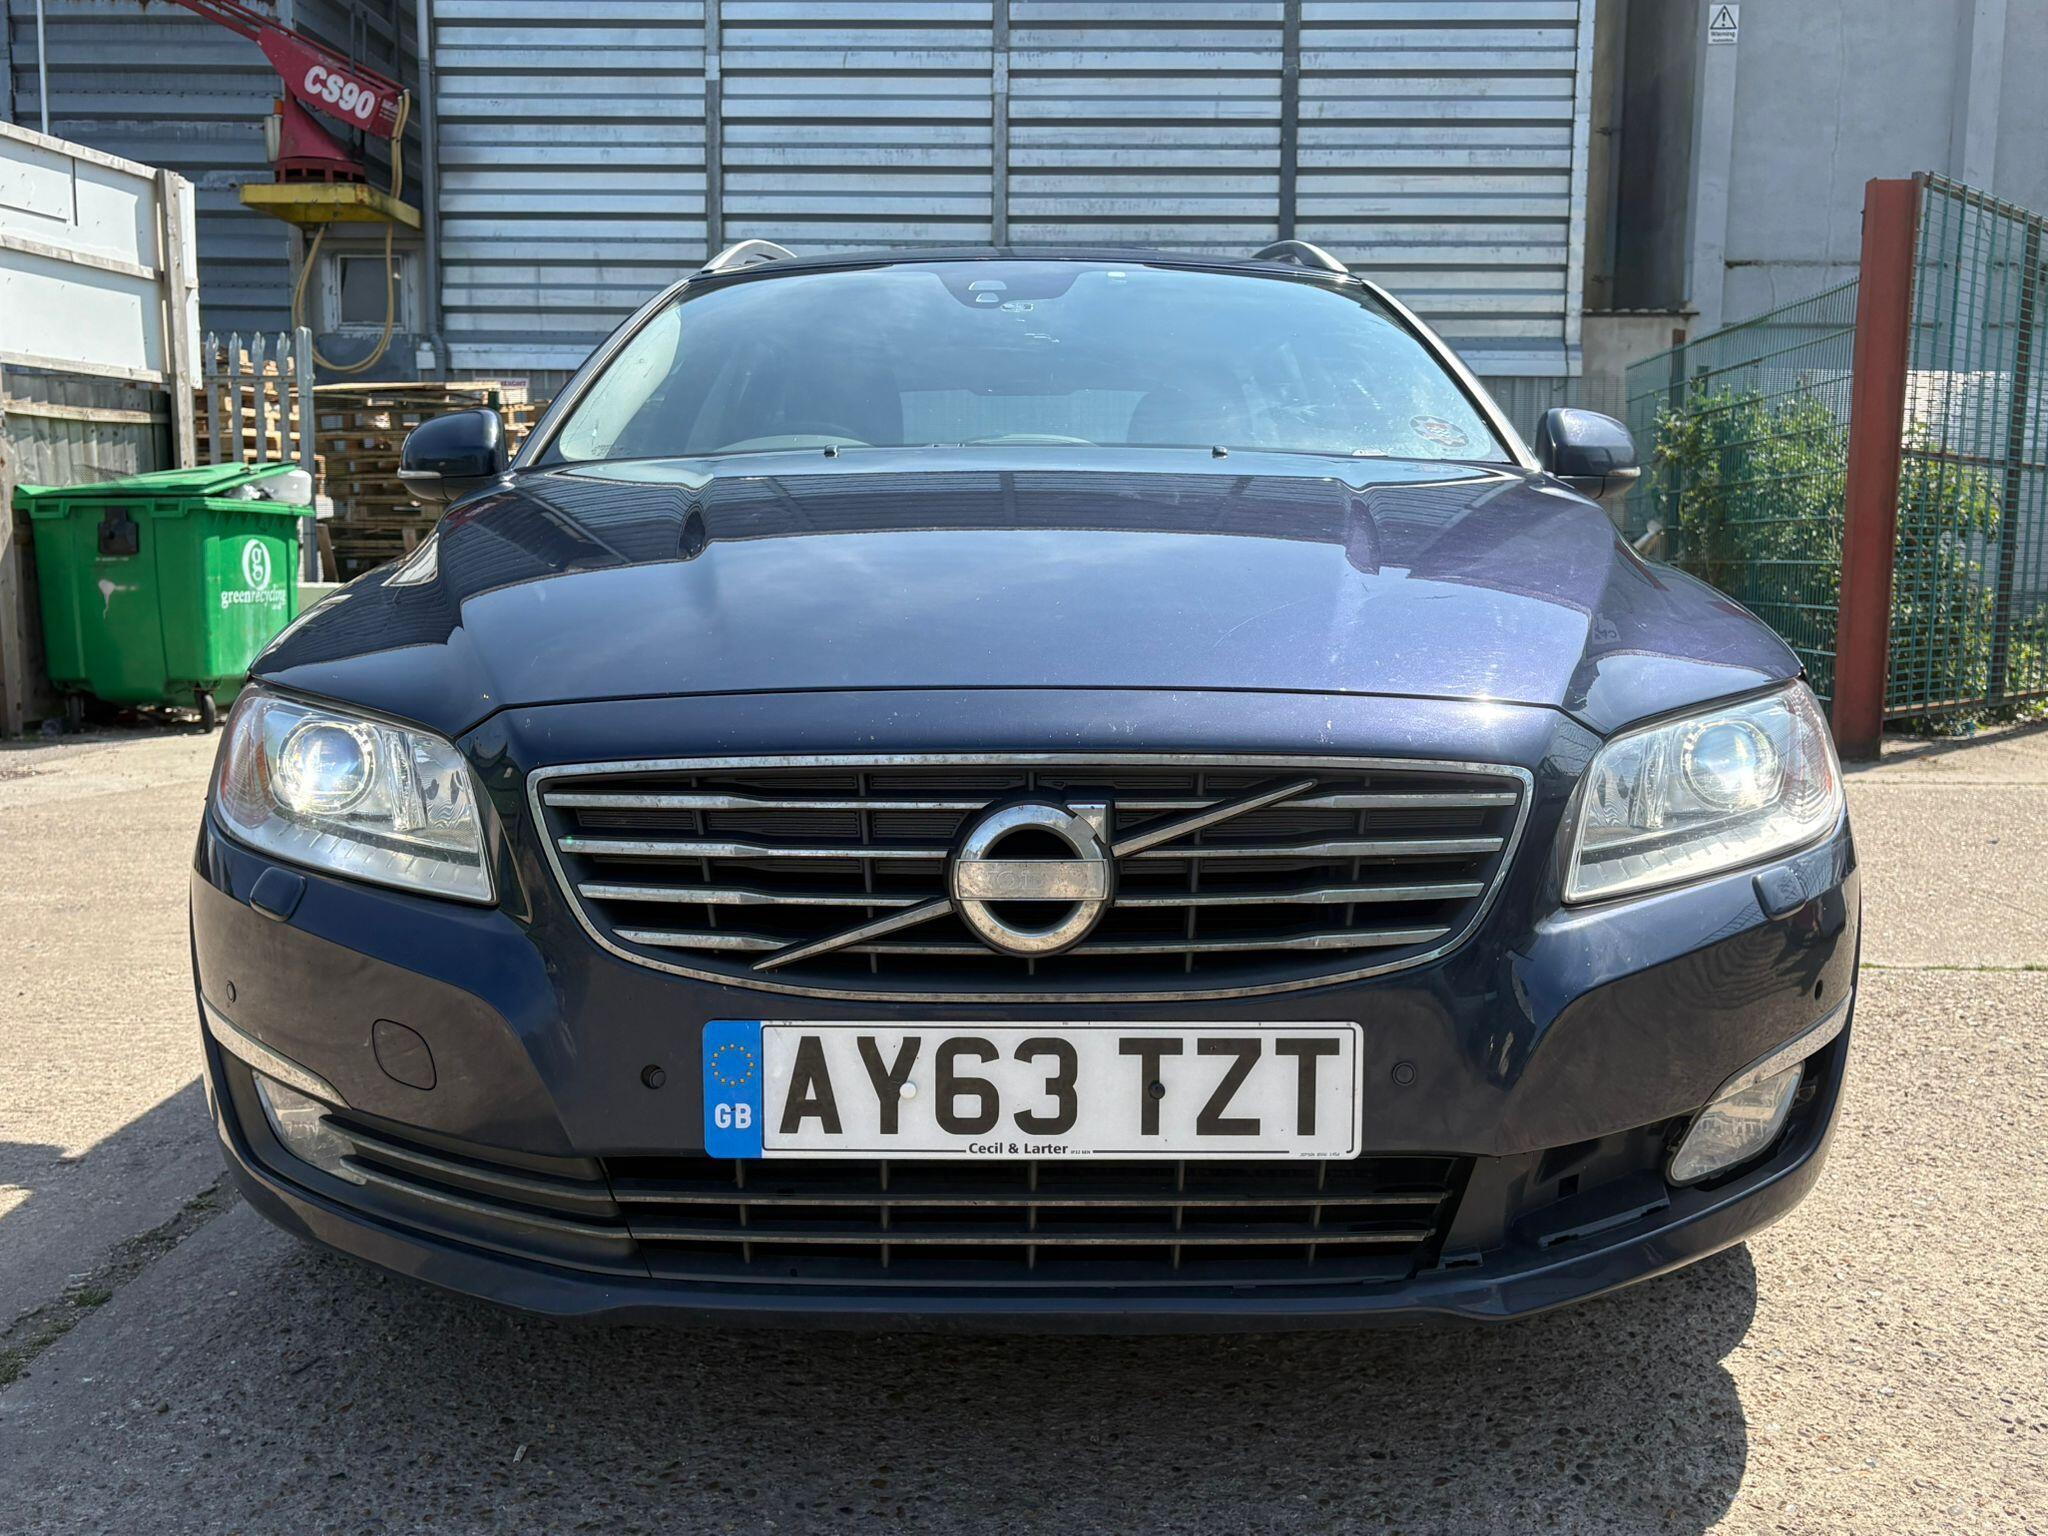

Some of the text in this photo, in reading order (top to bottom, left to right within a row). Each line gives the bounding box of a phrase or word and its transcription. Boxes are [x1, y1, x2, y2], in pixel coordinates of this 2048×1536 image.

[304, 65, 375, 119] CS90
[779, 1036, 1340, 1136] AY63 TZT
[714, 1103, 752, 1129] GB
[968, 1142, 1003, 1154] Cecil
[1008, 1143, 1019, 1154] &
[1024, 1142, 1069, 1154] Larter
